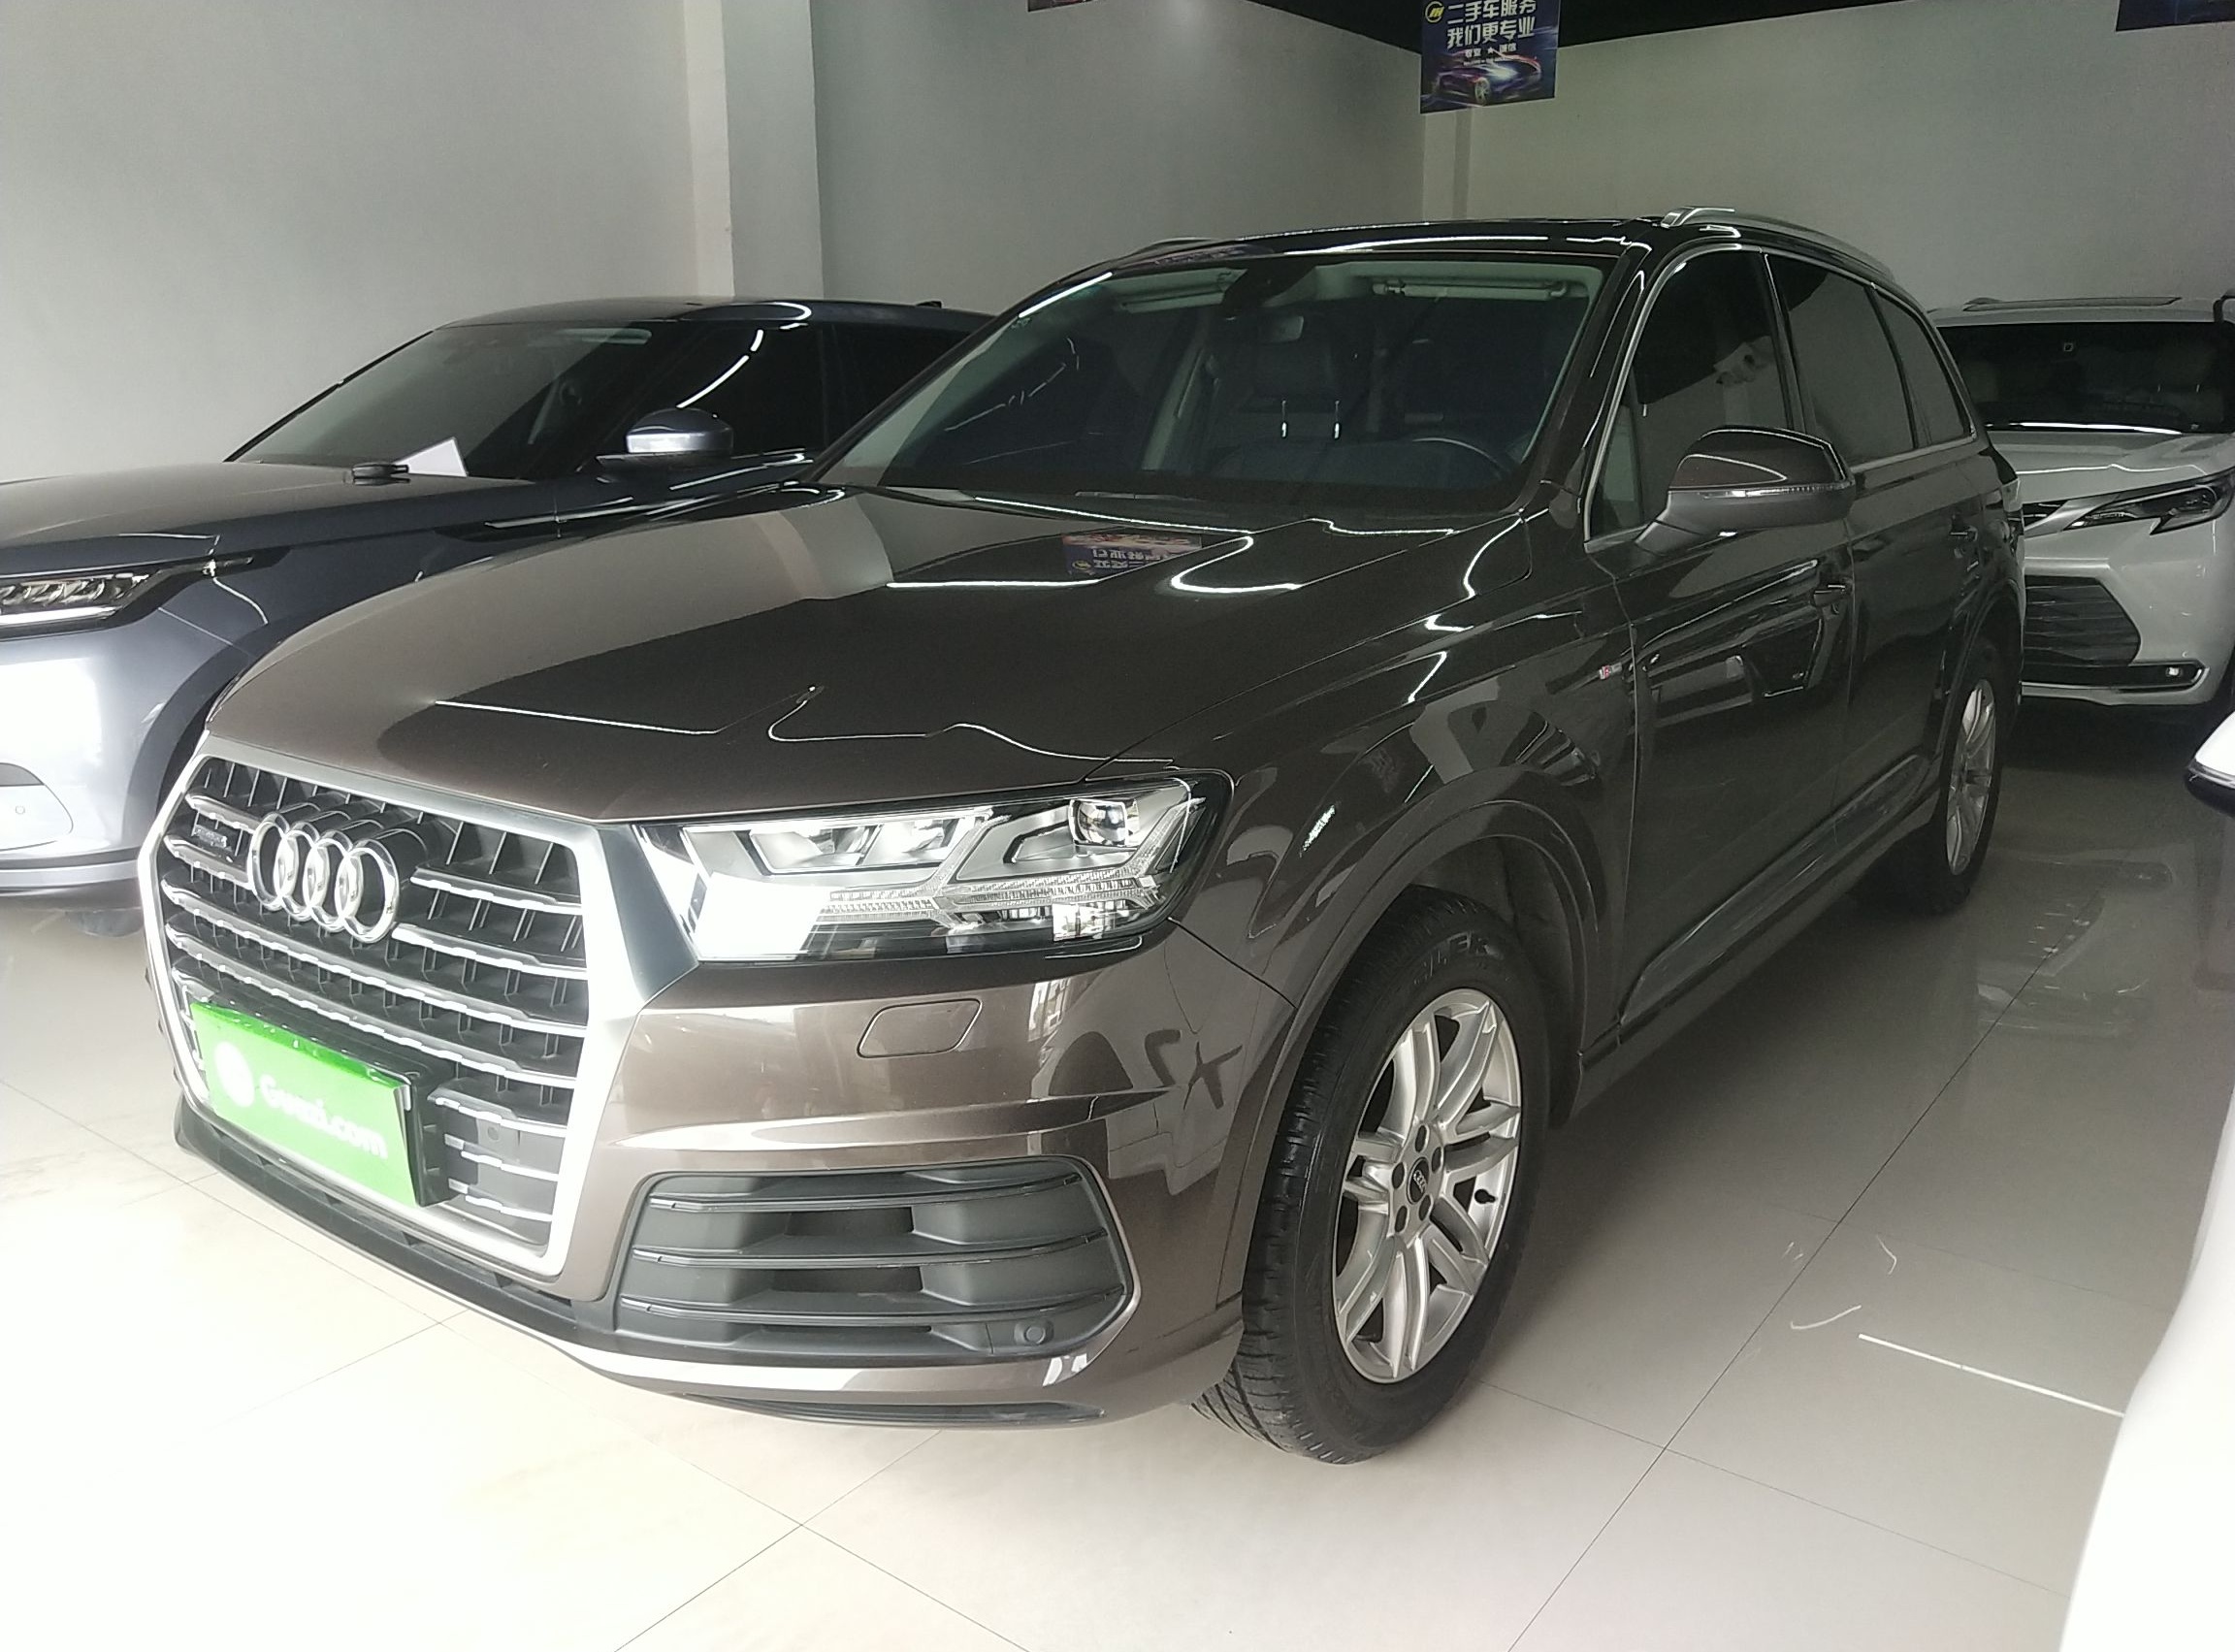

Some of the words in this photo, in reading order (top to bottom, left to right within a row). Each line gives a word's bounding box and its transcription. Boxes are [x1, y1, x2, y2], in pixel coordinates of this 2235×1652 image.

[1447, 0, 1537, 24] 二手车服务
[1447, 16, 1536, 49] 我们更专业
